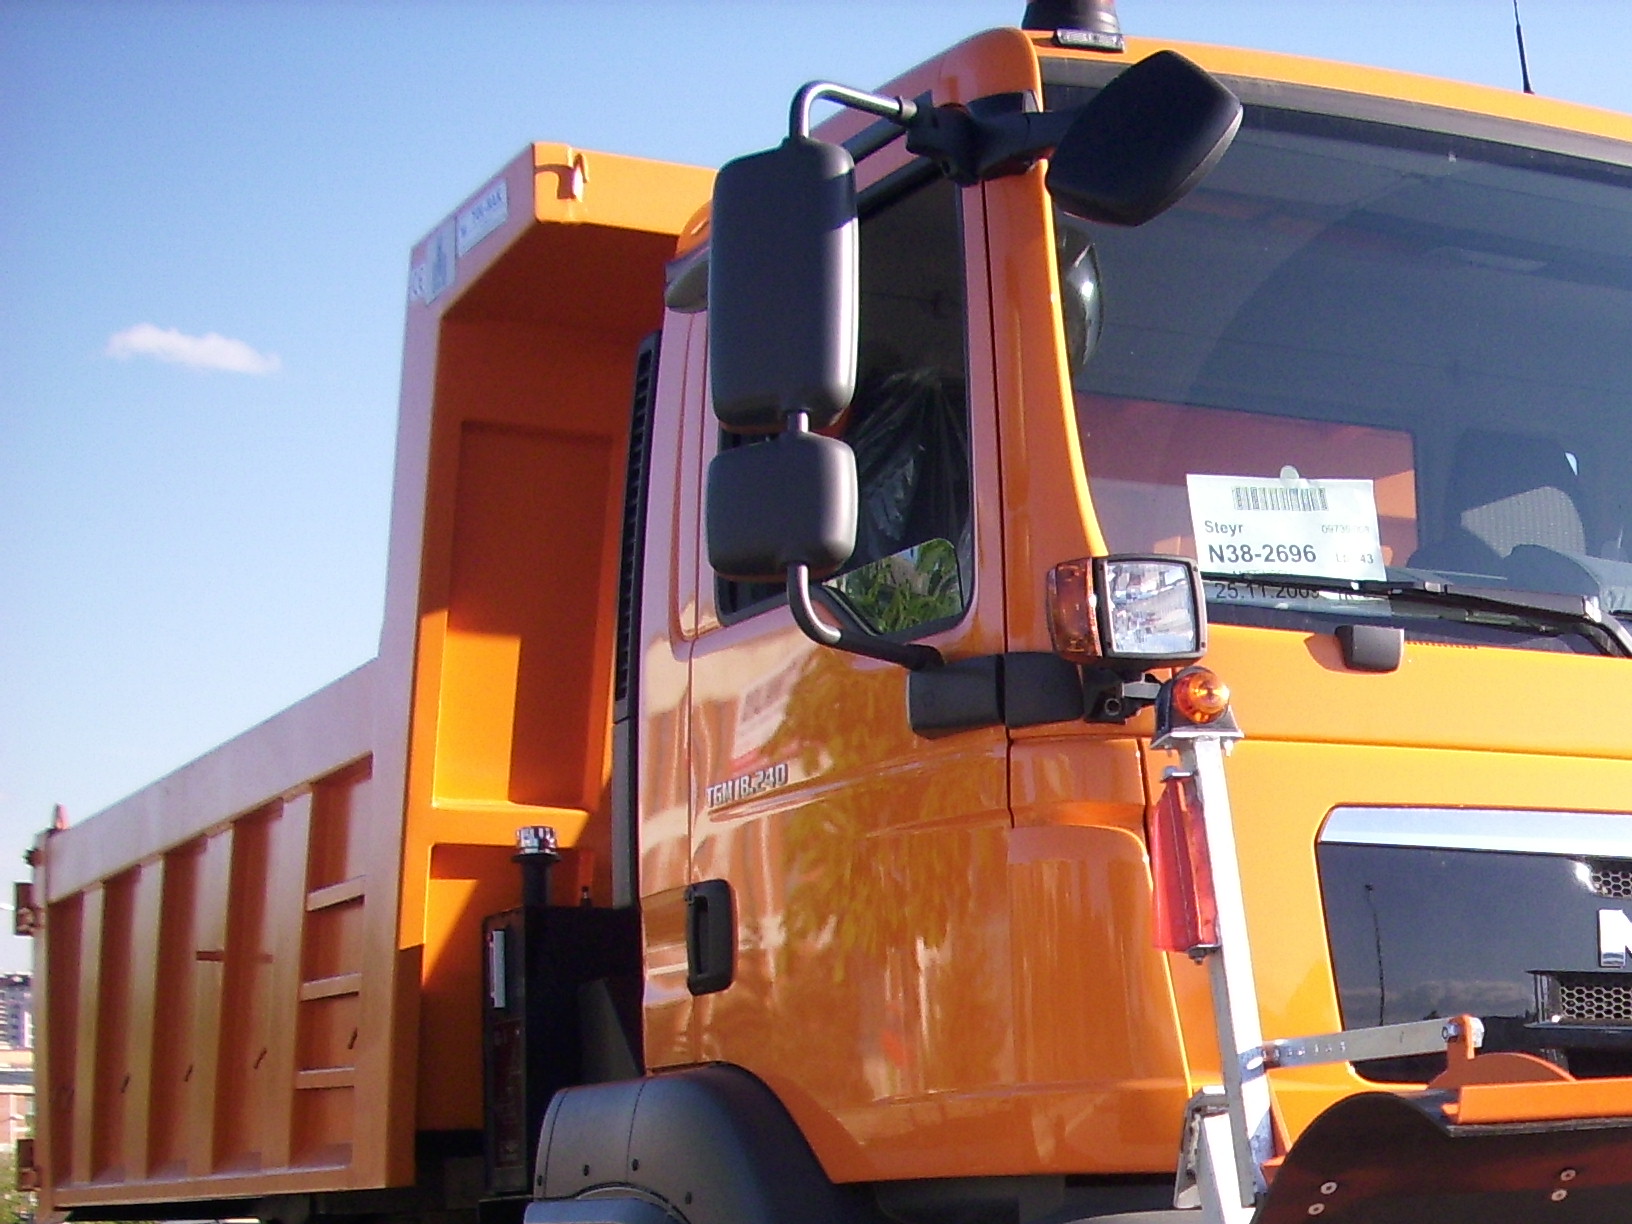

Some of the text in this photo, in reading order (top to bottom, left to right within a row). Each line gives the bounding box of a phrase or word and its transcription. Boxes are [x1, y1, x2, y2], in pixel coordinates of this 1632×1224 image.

[1204, 520, 1244, 537] Steyr
[1208, 544, 1317, 563] N38-2696
[1360, 553, 1375, 565] 43
